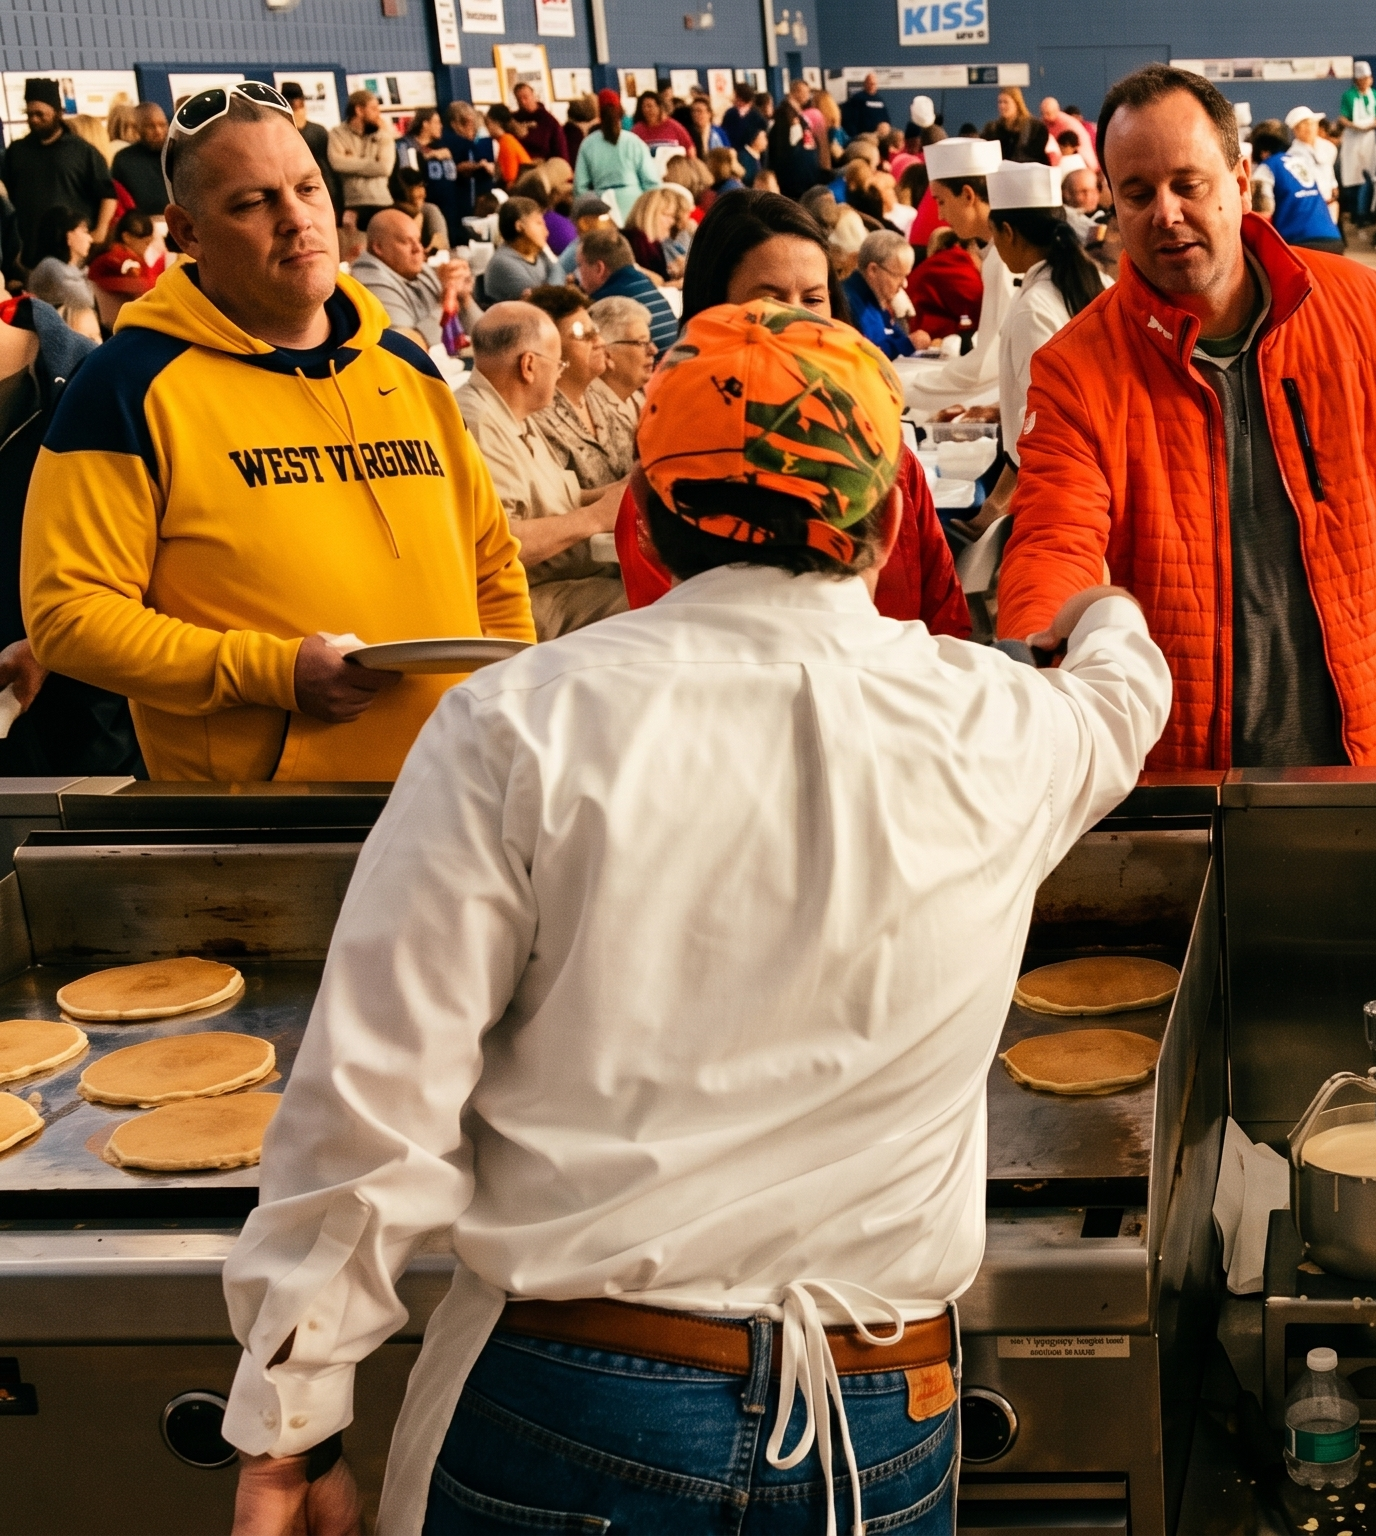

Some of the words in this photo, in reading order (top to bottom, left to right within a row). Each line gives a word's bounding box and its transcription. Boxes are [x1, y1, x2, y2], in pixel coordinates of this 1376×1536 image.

[904, 0, 984, 36] KISS
[229, 446, 324, 488] WEST
[325, 439, 445, 482] VIRGINIA
